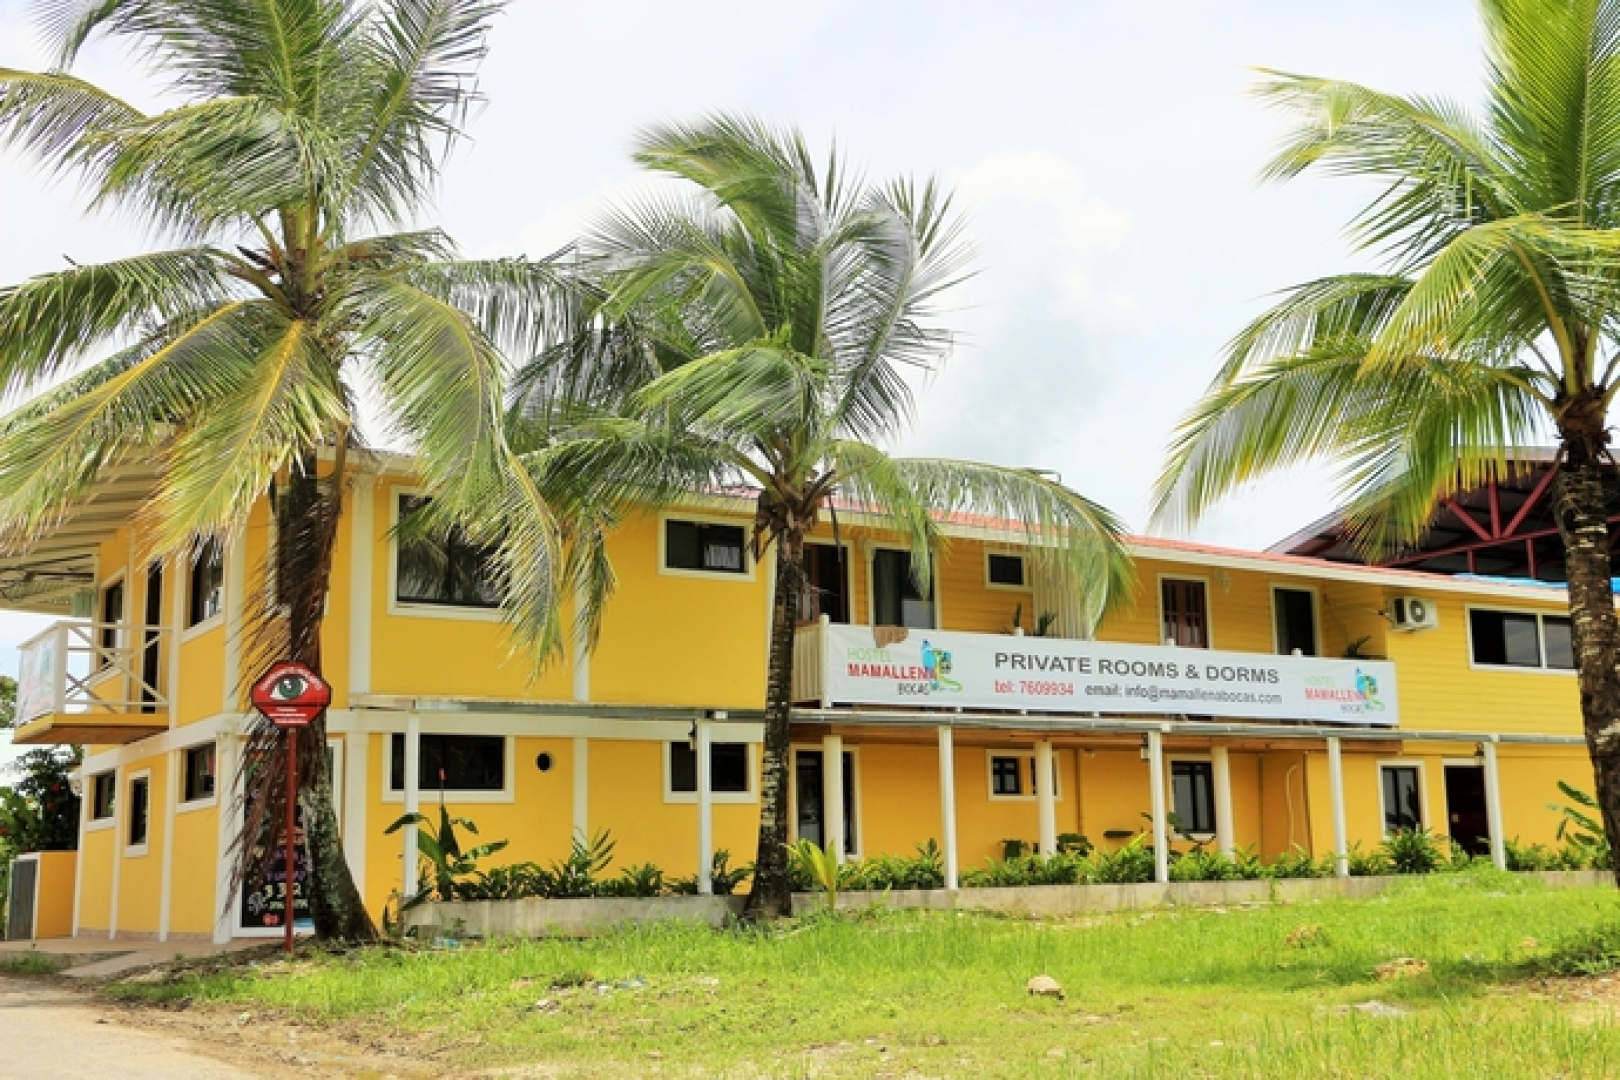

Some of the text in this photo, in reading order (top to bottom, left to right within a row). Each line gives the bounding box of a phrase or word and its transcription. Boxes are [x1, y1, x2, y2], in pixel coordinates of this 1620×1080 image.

[994, 653, 1280, 684] PRIVATE ROOMS & DORMS
[994, 680, 1014, 694] tel:
[1019, 681, 1075, 696] 7609934
[1084, 683, 1122, 698] email:
